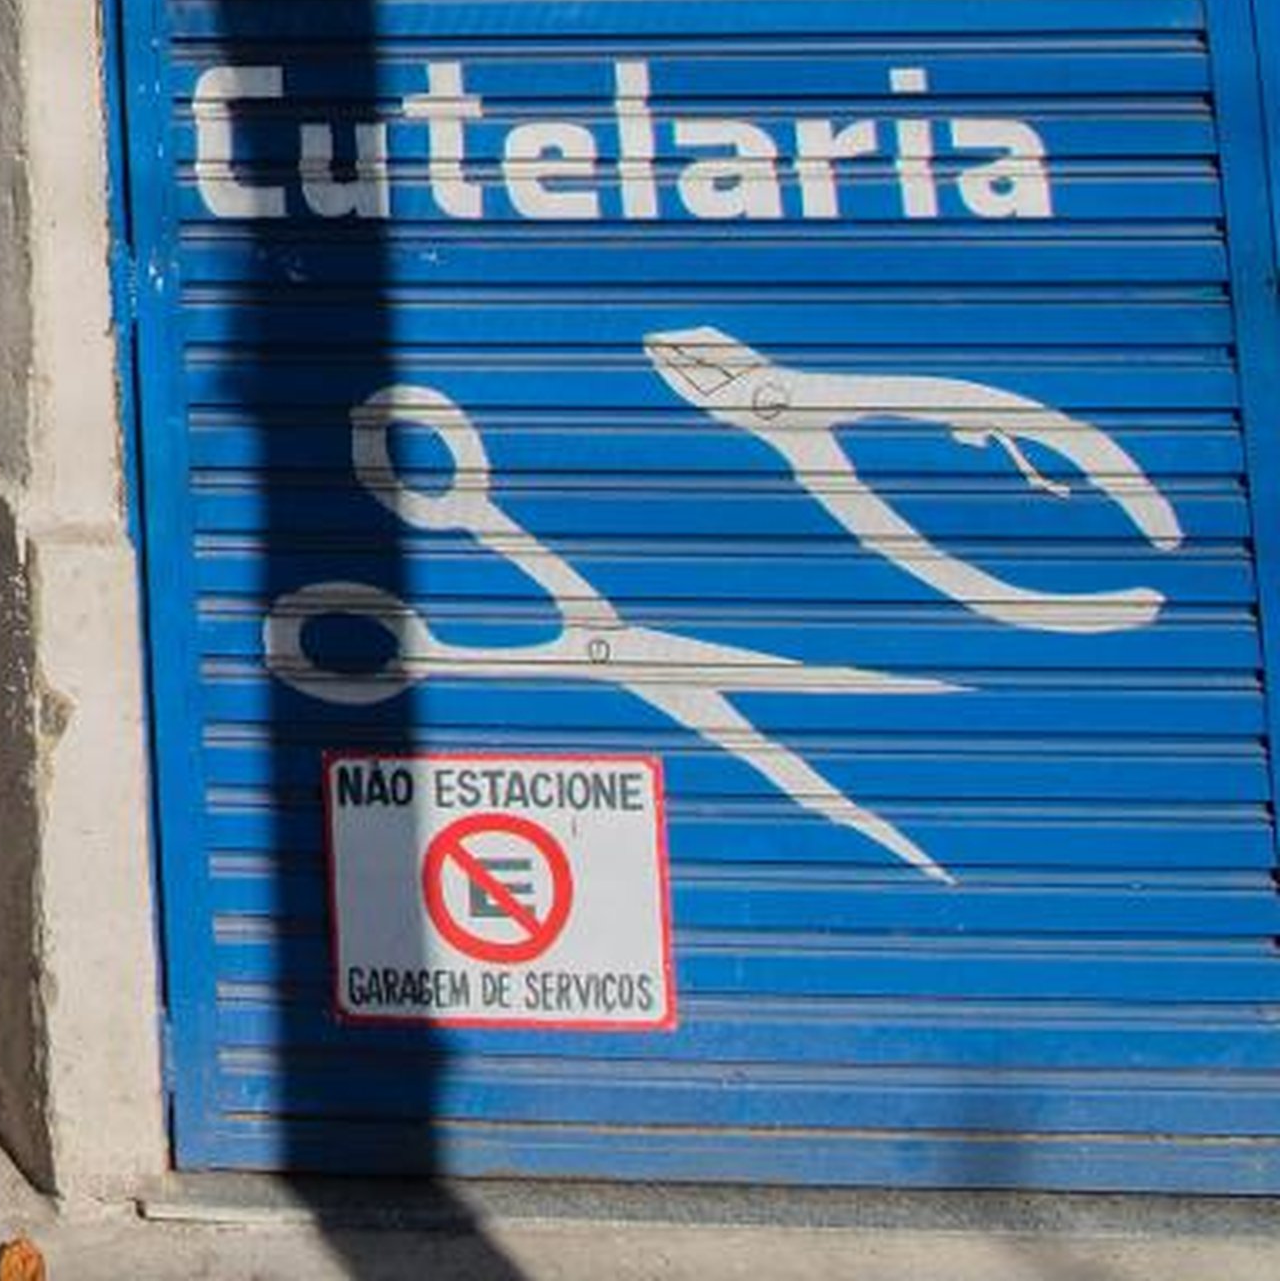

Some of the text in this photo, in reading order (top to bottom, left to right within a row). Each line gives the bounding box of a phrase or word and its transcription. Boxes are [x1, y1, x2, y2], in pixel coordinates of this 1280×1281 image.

[191, 58, 1053, 219] Cutelaria
[338, 760, 644, 811] NÃO ESTACIONE
[348, 967, 654, 1013] GARAGEM DE SERVIÇOS
